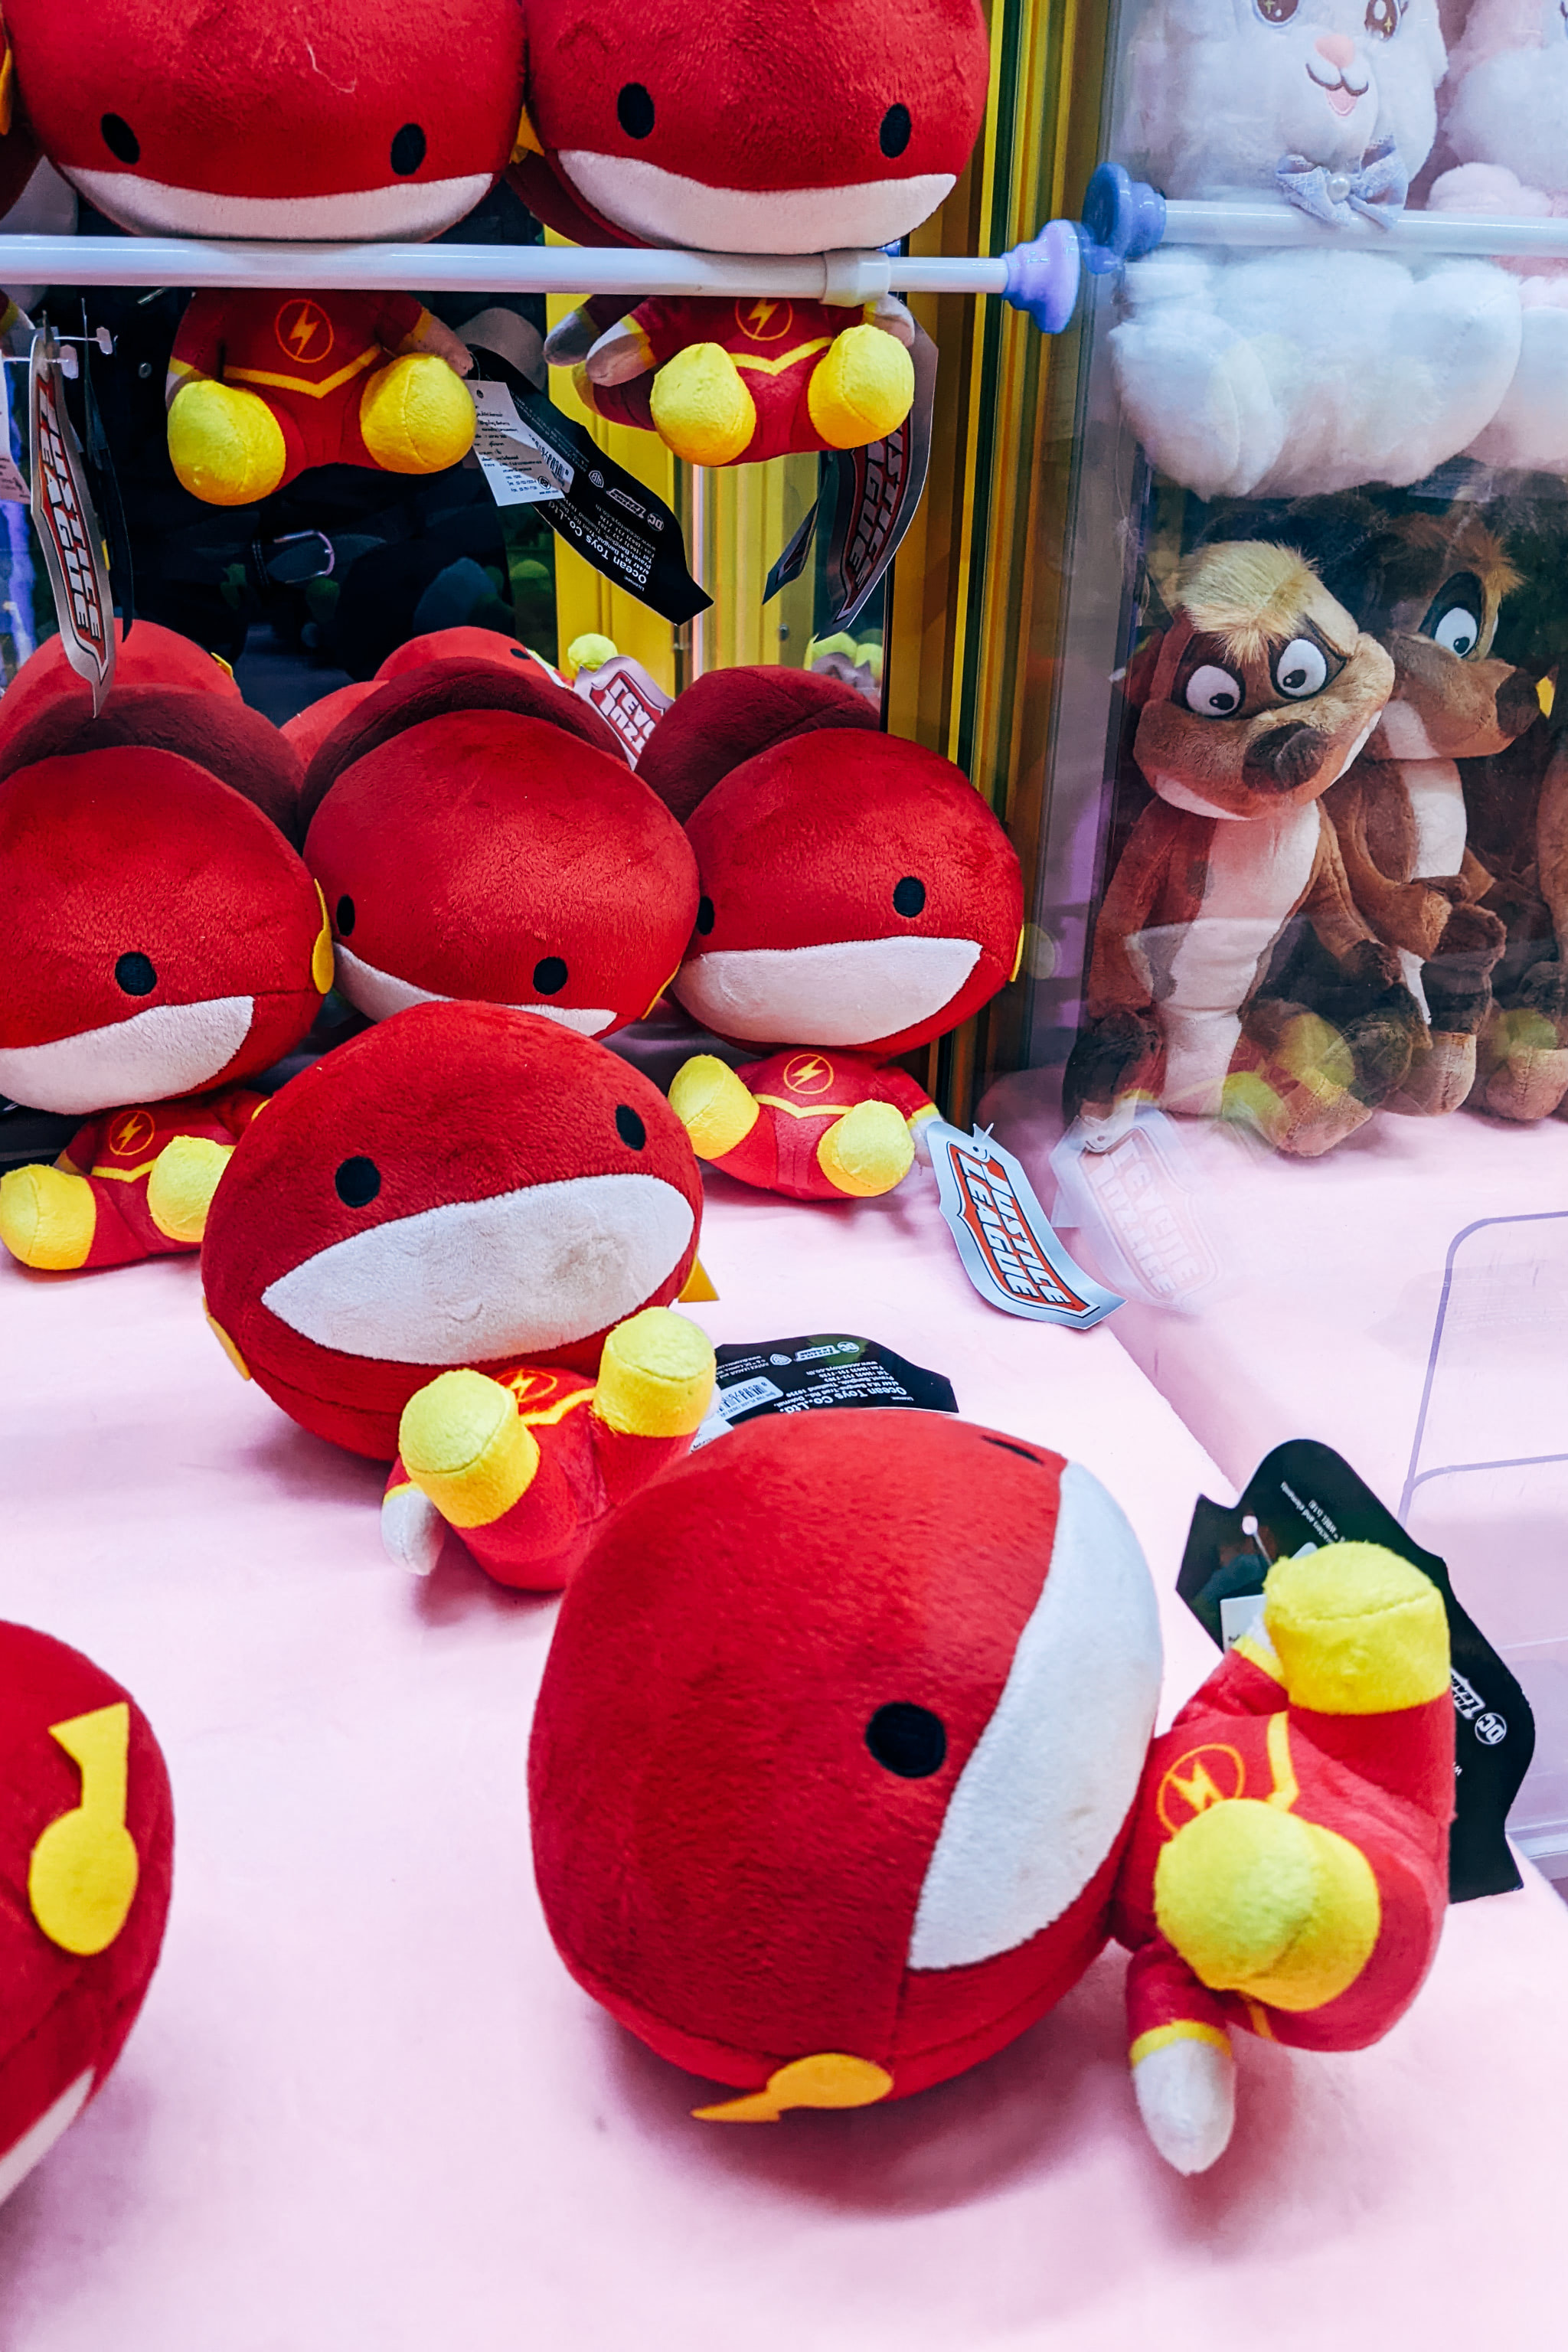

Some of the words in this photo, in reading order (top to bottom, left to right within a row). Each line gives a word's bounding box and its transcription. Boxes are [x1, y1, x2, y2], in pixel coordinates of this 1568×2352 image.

[39, 387, 90, 631] LEAGUE
[46, 390, 101, 640] JUSTICE
[849, 441, 885, 572] AGUE
[856, 426, 903, 587] USTICE
[578, 512, 600, 534] Thailand
[647, 512, 665, 532] DC
[586, 535, 607, 559] Toys
[613, 553, 646, 583] Ocean
[956, 1152, 1038, 1299] LEAGUE
[978, 1164, 1071, 1306] JUSTICE
[834, 1386, 867, 1398] Toys
[867, 1383, 906, 1397] Ocean
[1302, 1509, 1314, 1521] and
[1476, 1714, 1505, 1743] DC
